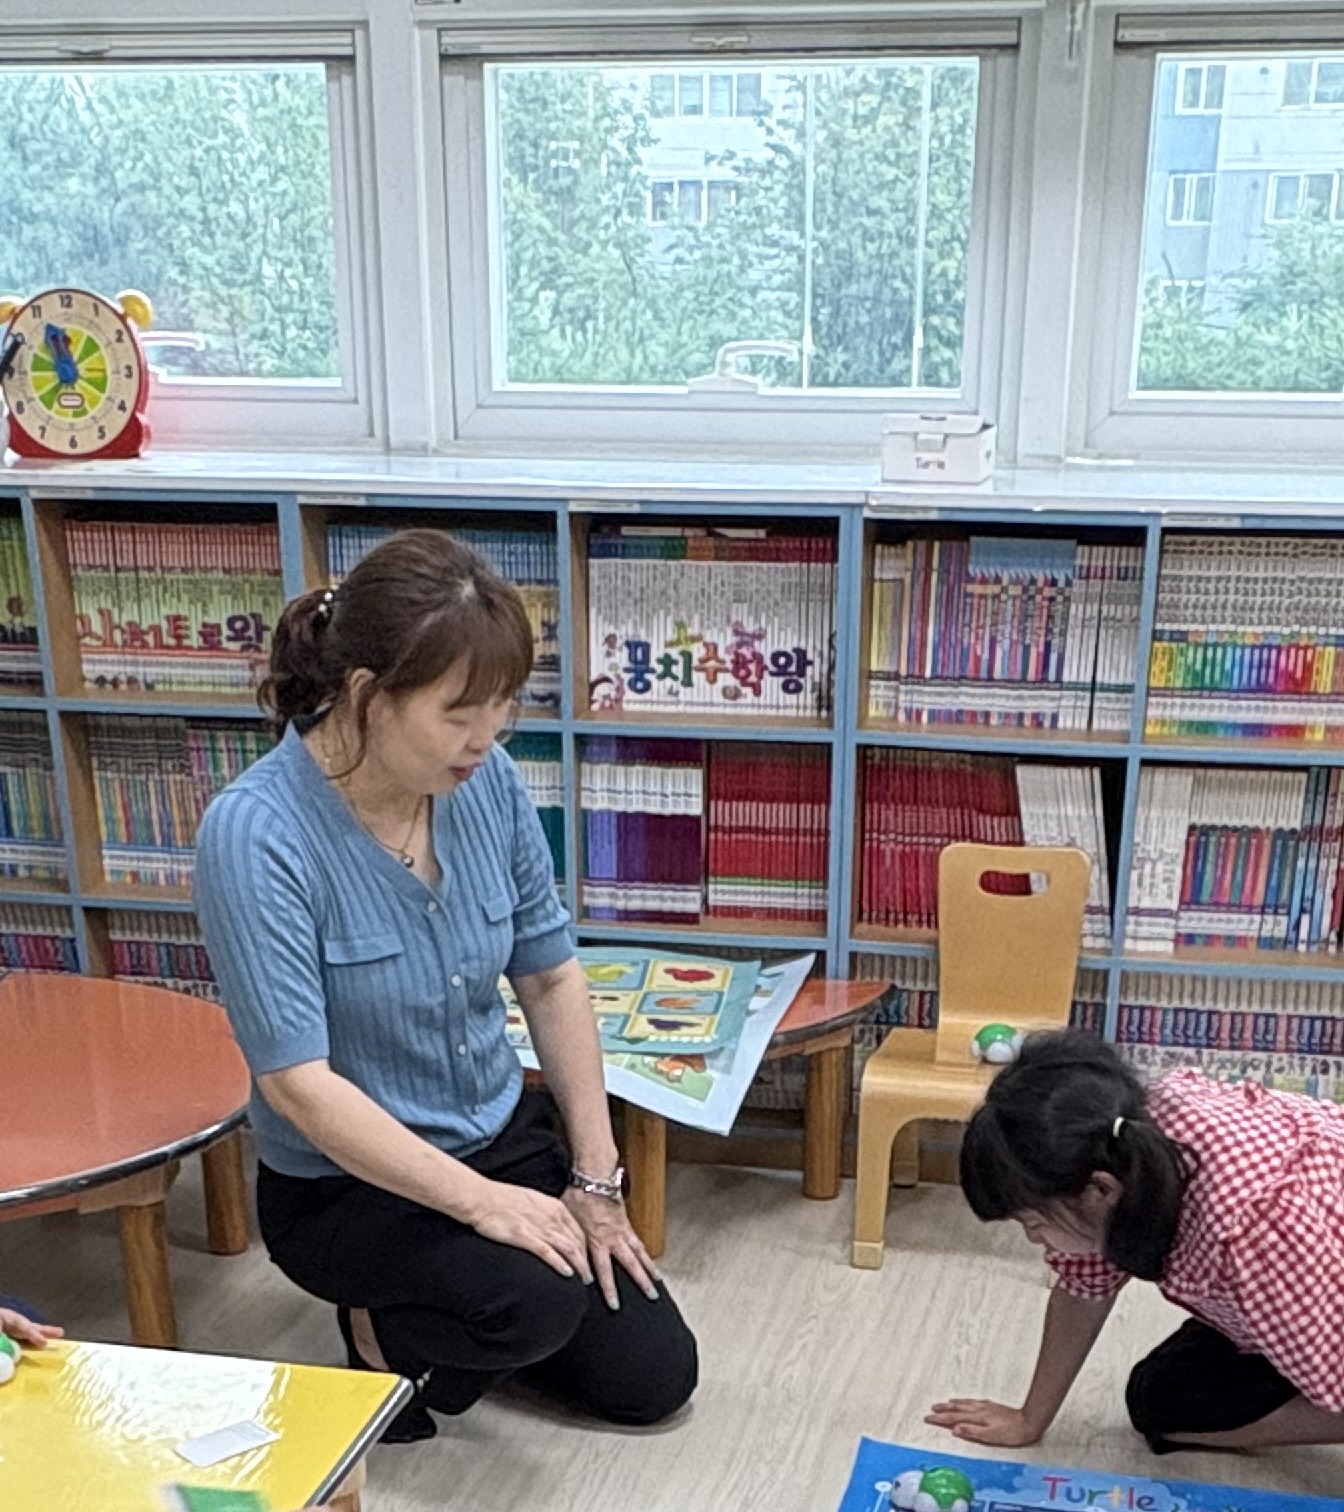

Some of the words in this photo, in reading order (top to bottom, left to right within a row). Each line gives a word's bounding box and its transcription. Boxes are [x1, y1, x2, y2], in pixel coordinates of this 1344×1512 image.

[58, 294, 73, 309] 12
[31, 304, 42, 319] 11
[92, 302, 100, 317] 1
[115, 329, 124, 343] 2
[124, 364, 133, 379] 3
[16, 400, 26, 414] 8
[117, 399, 127, 413] 4
[38, 426, 47, 439] 7
[97, 426, 106, 439] 5
[68, 435, 78, 449] 6
[623, 638, 813, 696] 뭉치수학왕
[1041, 1475, 1157, 1512] Turtle
